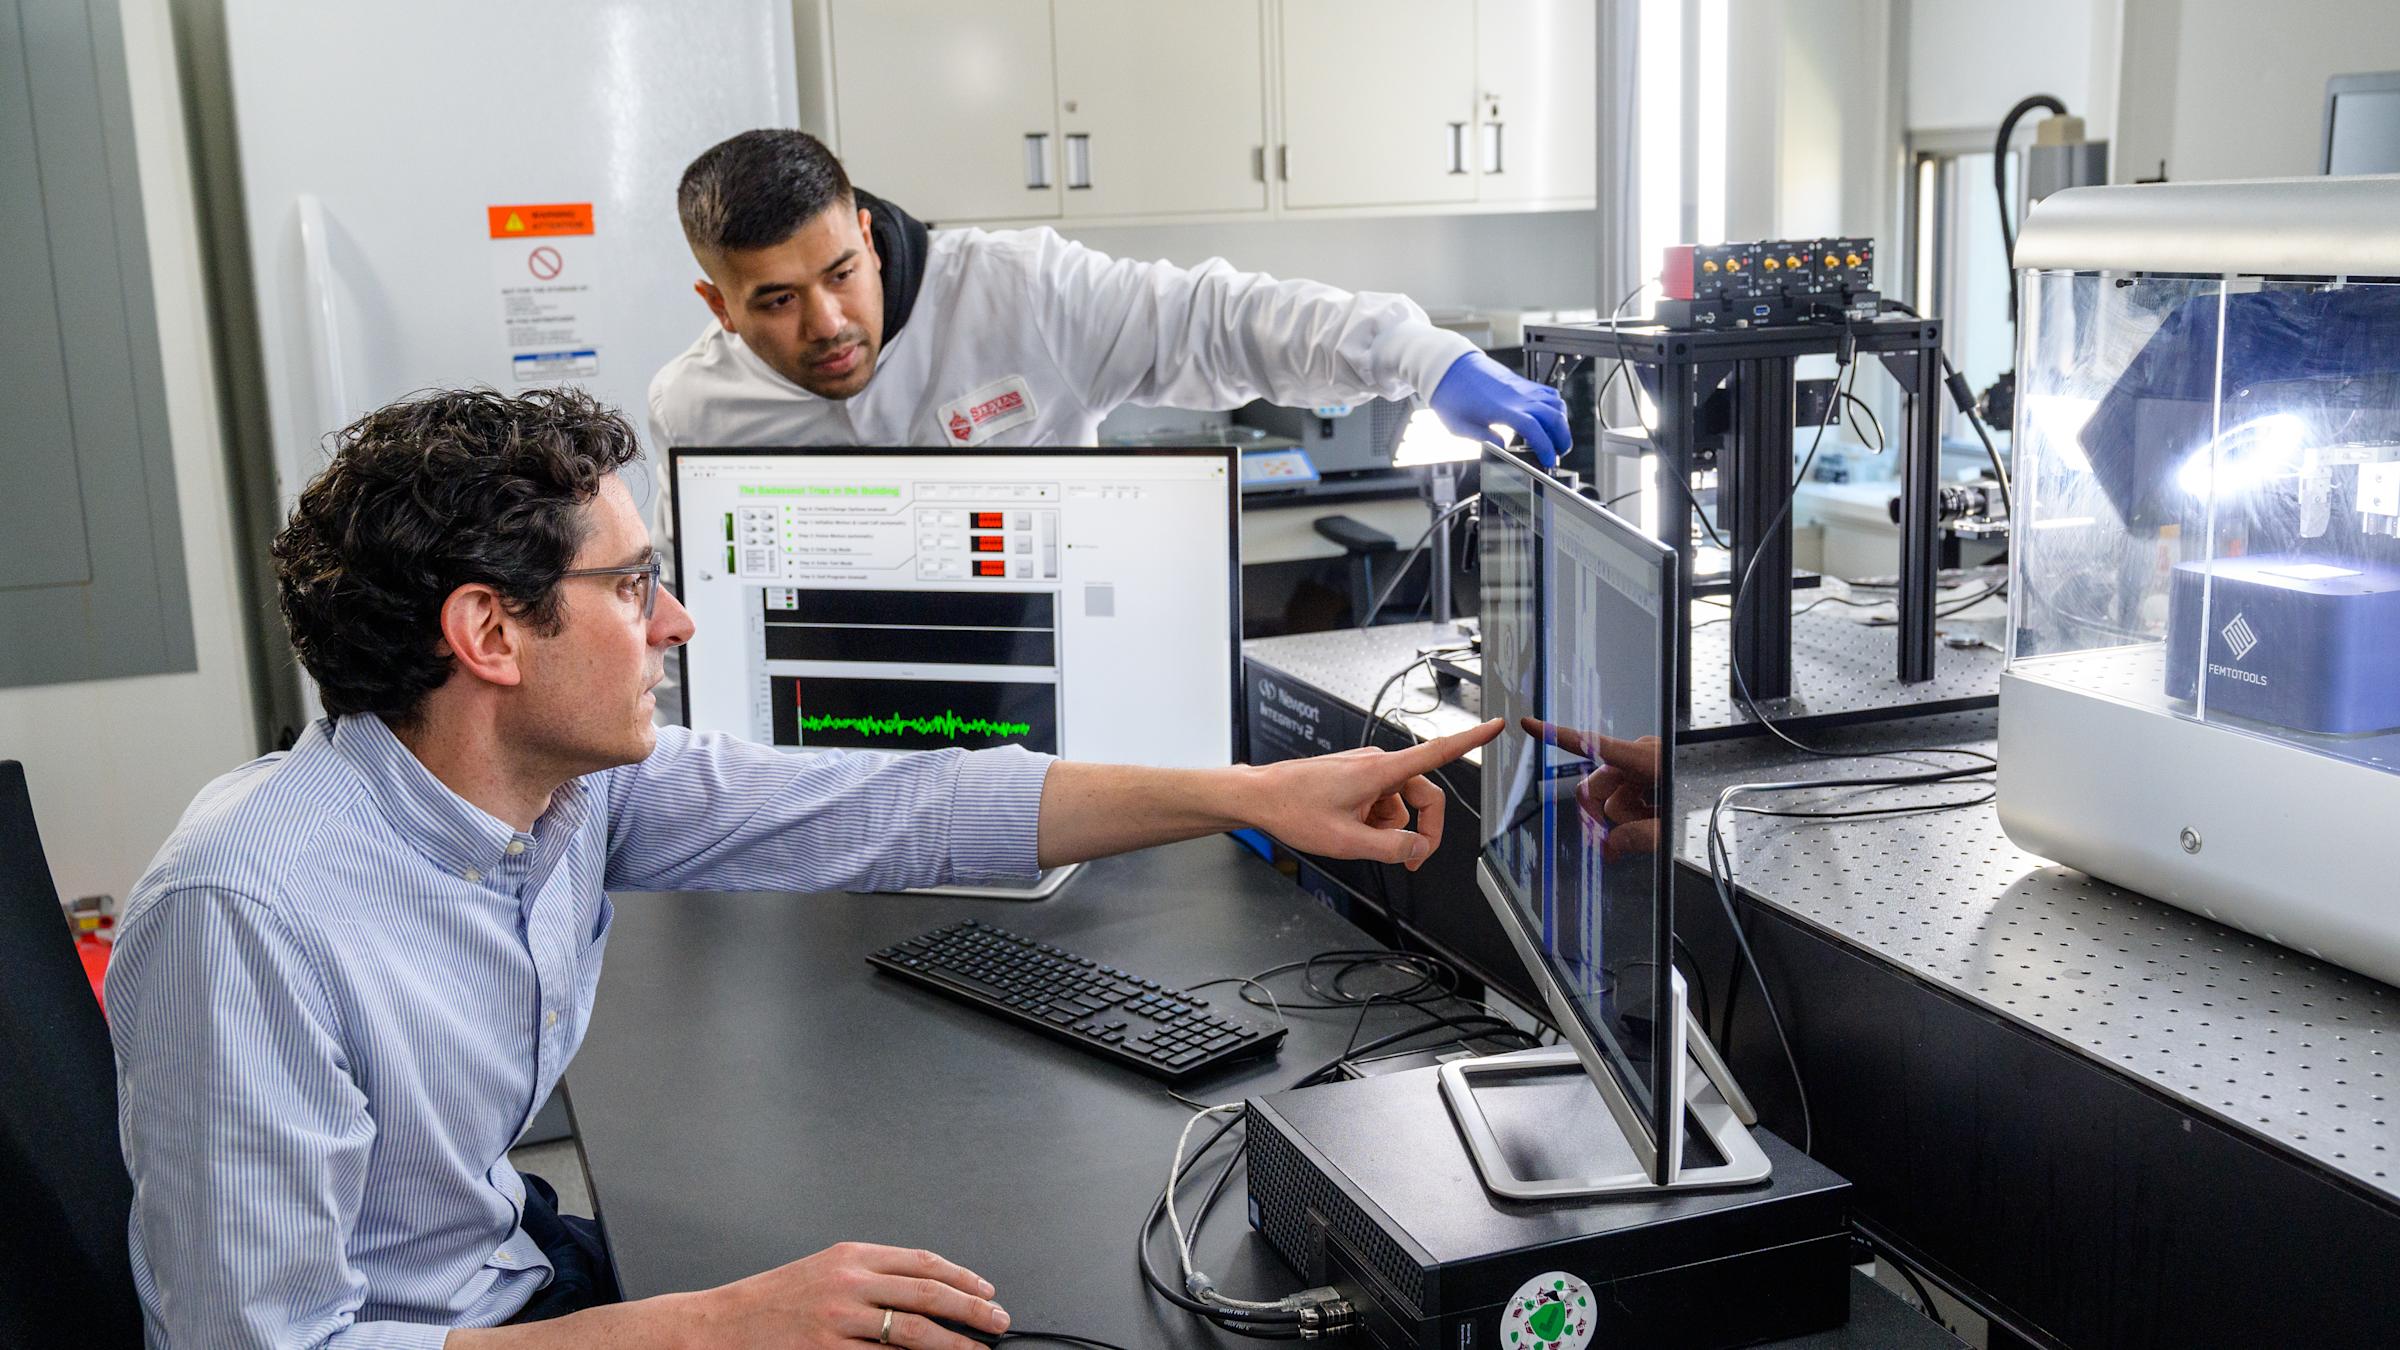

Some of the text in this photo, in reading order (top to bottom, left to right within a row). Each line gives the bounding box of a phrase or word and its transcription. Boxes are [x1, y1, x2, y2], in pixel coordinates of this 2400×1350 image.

[2208, 663, 2268, 686] FEMTOTOOLS
[1278, 688, 1321, 723] Newport
[1304, 724, 1315, 741] 2
